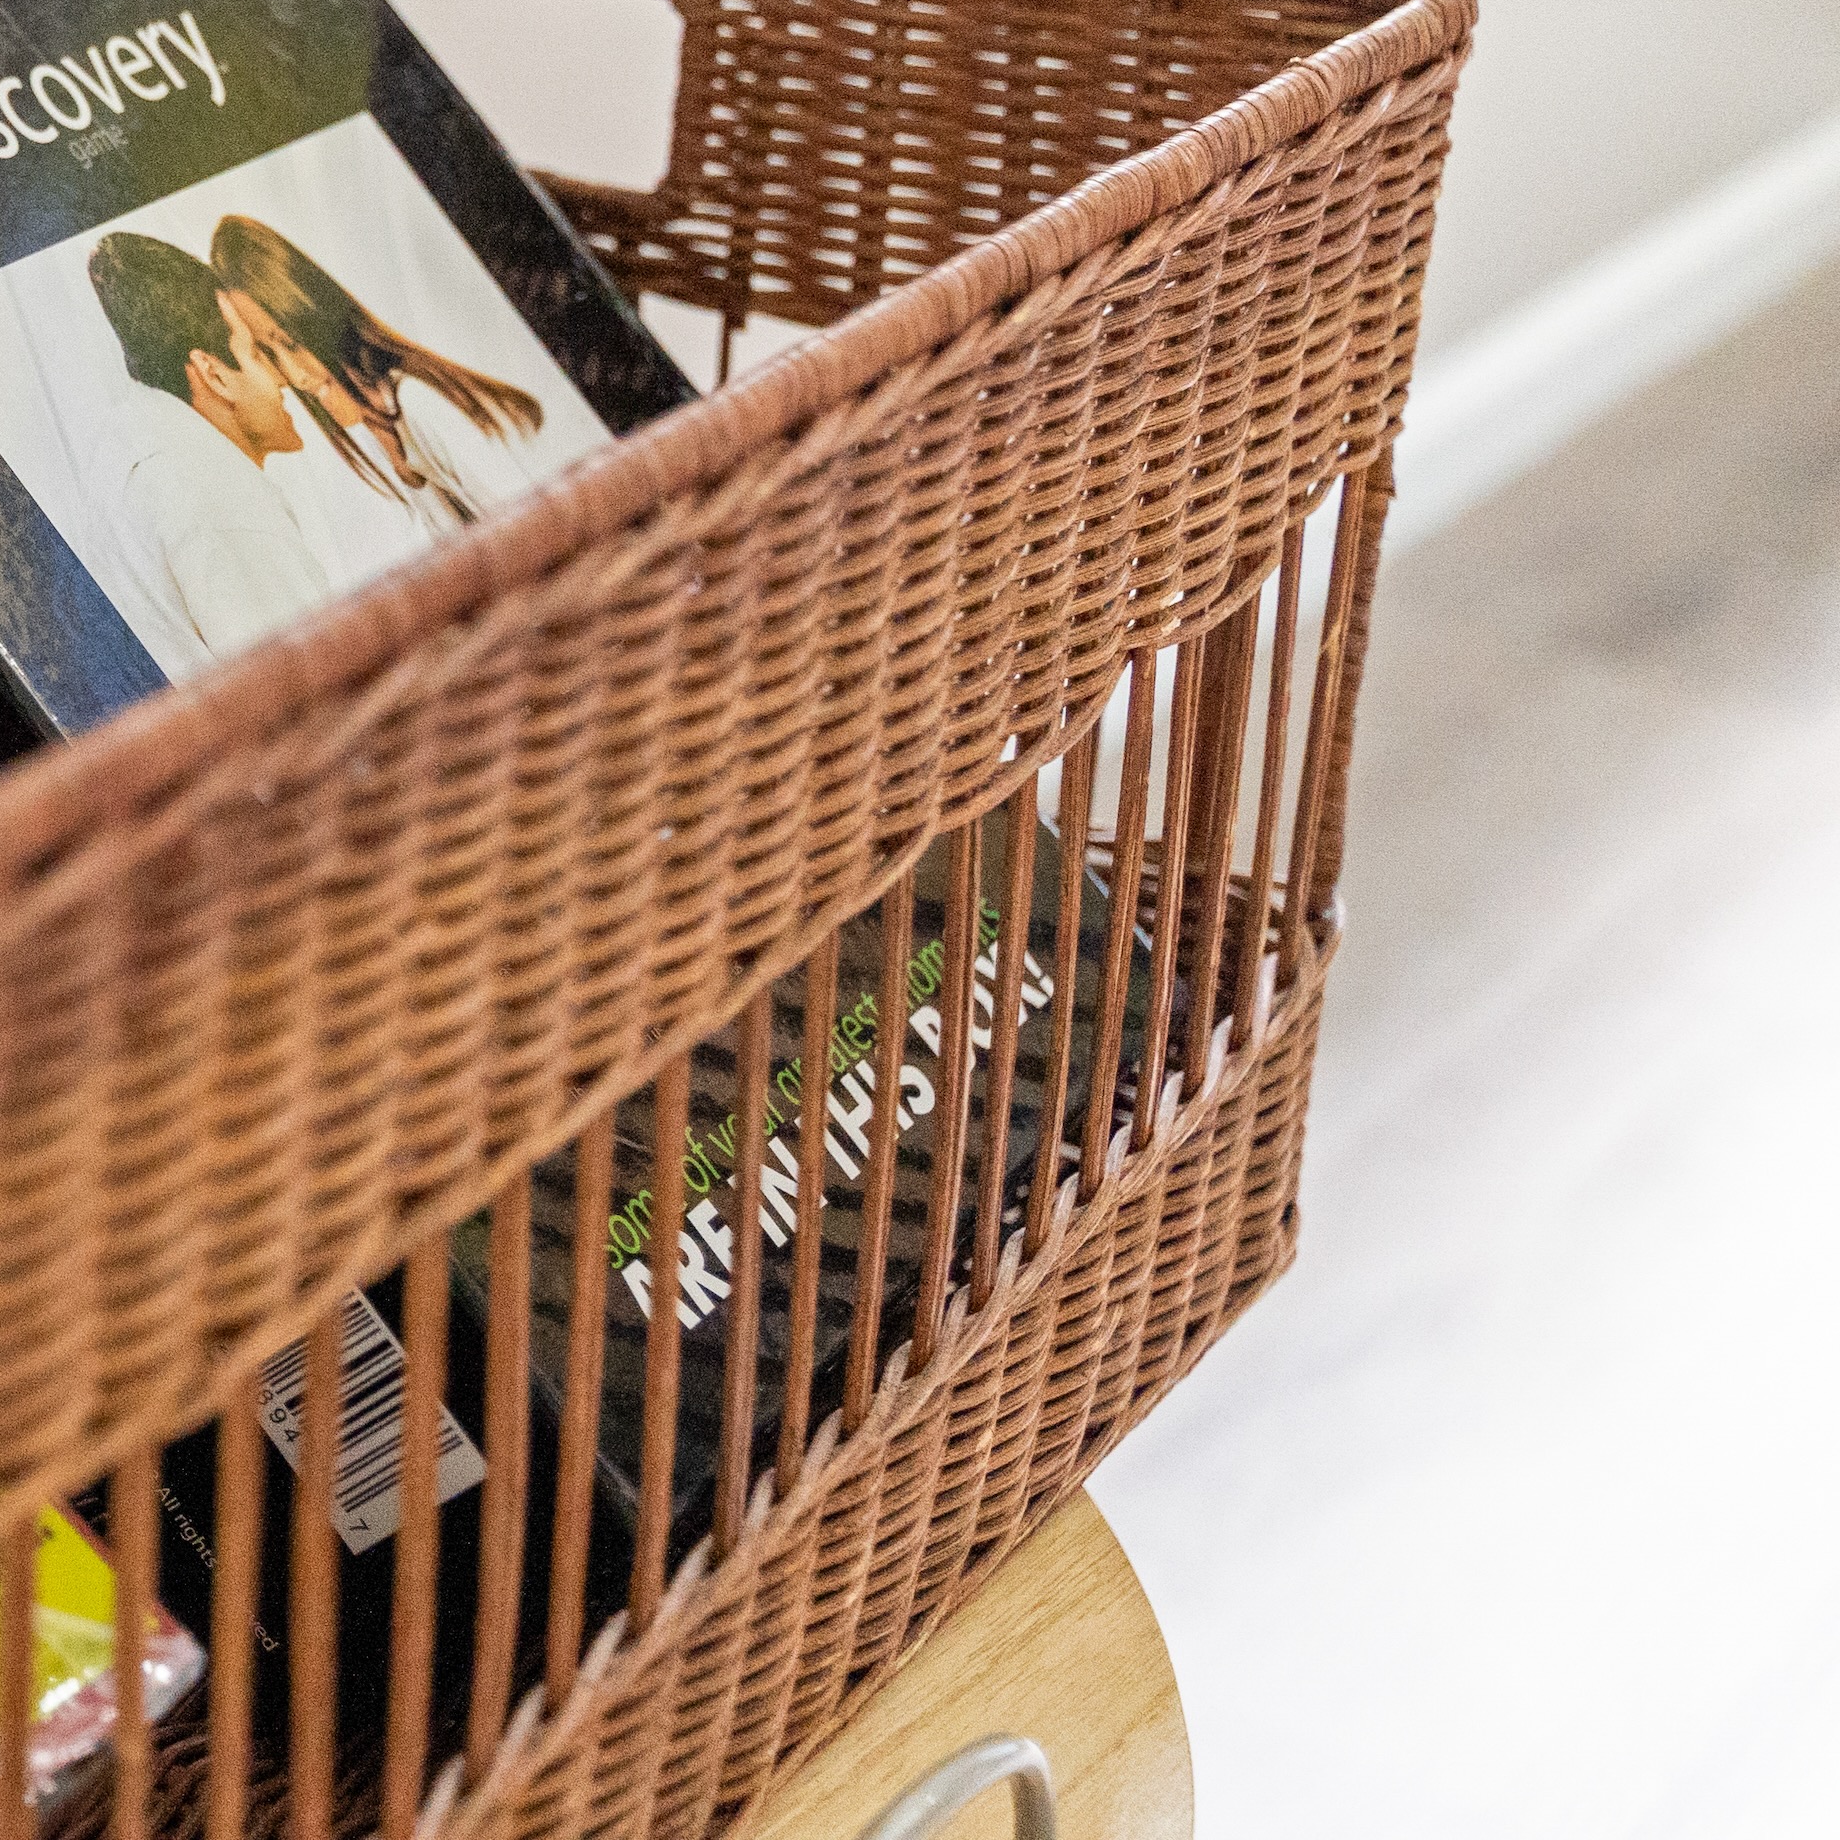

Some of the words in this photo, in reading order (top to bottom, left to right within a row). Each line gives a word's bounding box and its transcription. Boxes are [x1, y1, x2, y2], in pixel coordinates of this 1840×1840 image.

[68, 124, 128, 171] game
[153, 1480, 184, 1514] All
[169, 1509, 221, 1575] rights
